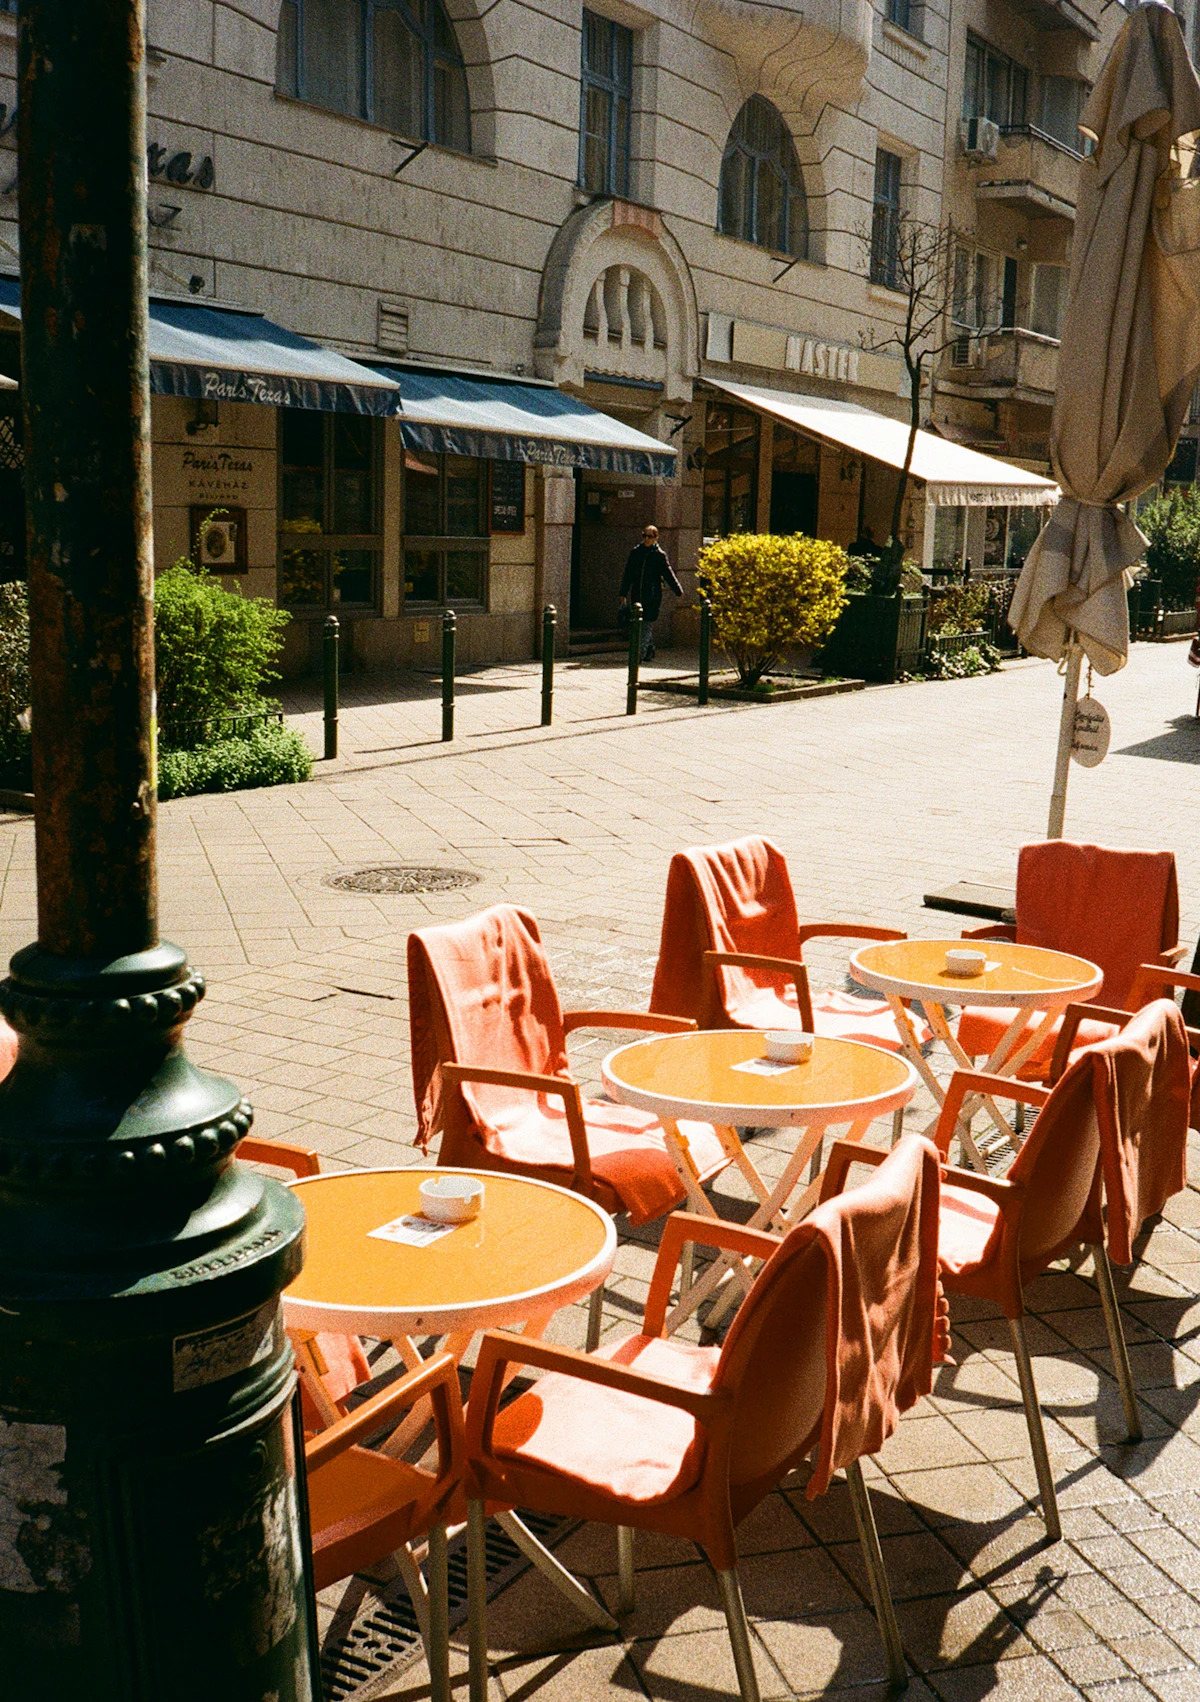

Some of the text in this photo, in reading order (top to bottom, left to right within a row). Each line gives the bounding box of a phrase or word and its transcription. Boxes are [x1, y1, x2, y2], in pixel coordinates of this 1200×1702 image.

[147, 143, 213, 189] xas
[785, 336, 859, 382] MASTER
[247, 378, 291, 405] Texas
[218, 453, 253, 472] Texas
